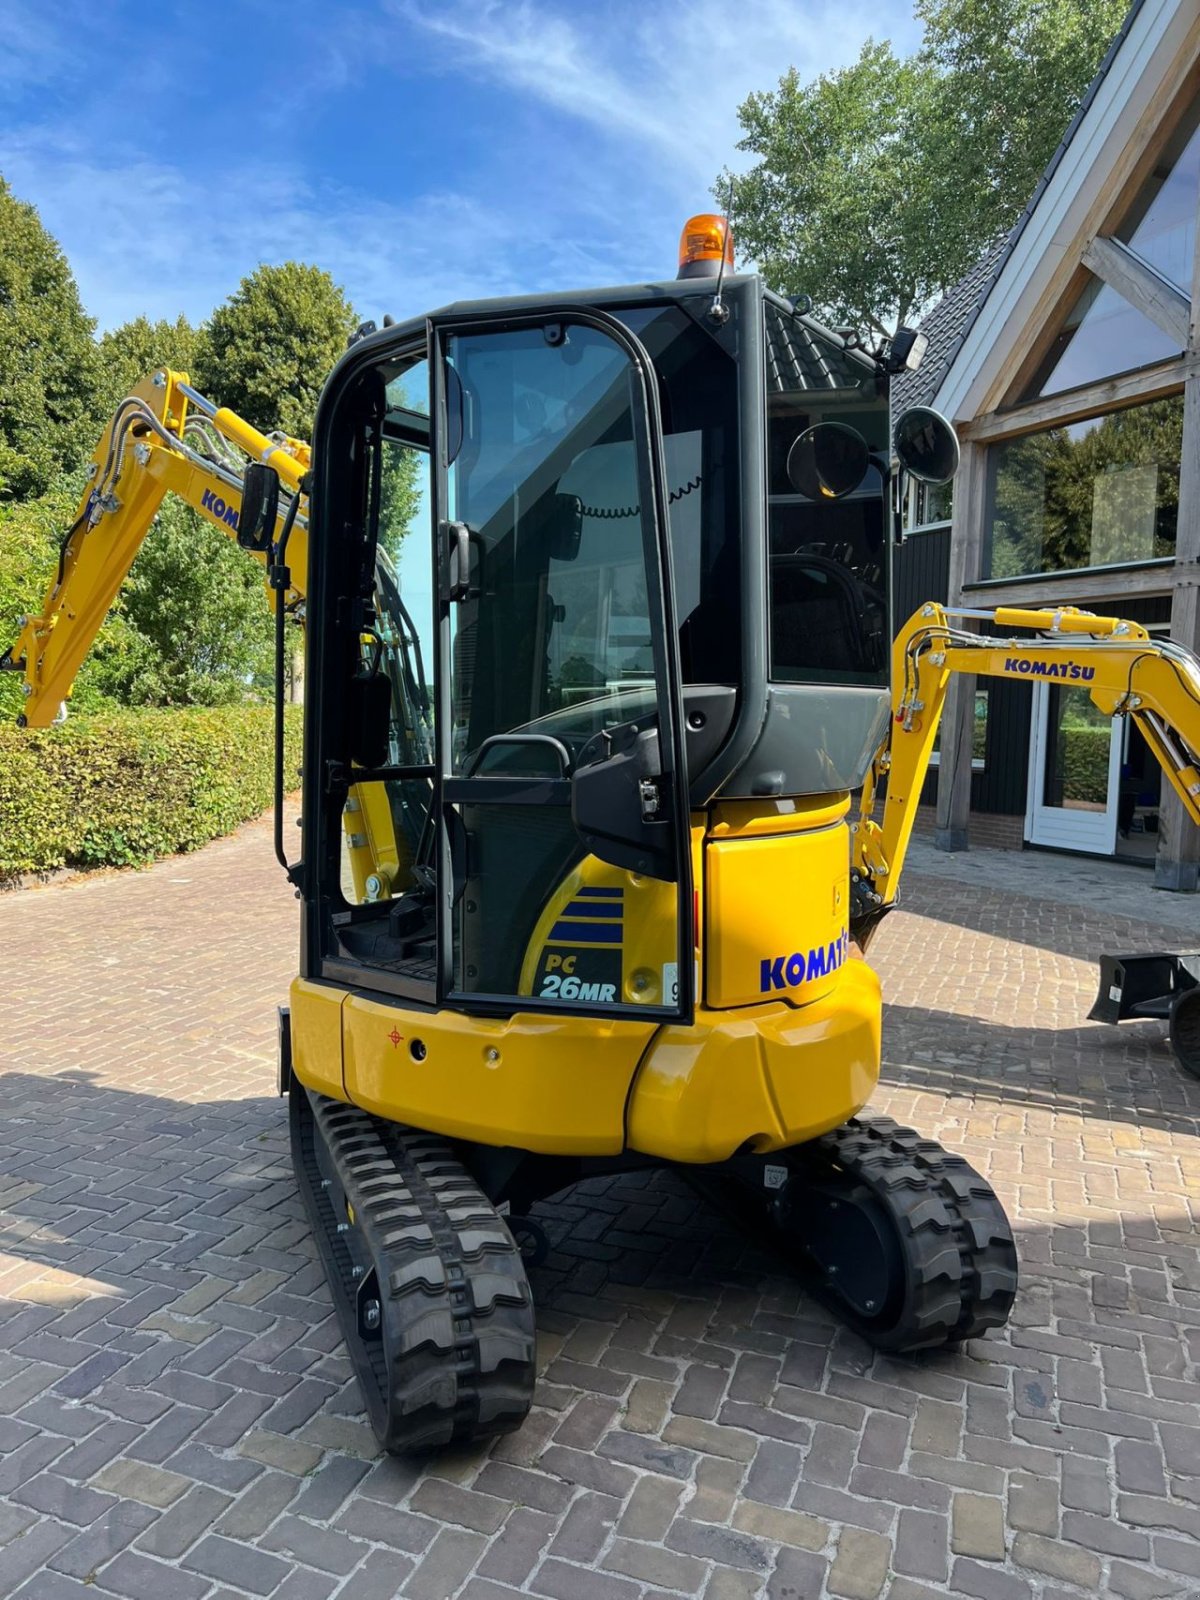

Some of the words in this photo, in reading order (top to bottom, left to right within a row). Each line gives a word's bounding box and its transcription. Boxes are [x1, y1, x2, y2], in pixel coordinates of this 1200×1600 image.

[1004, 657, 1095, 681] KOMATSU
[545, 953, 577, 974] PC
[539, 974, 617, 1002] 26MR
